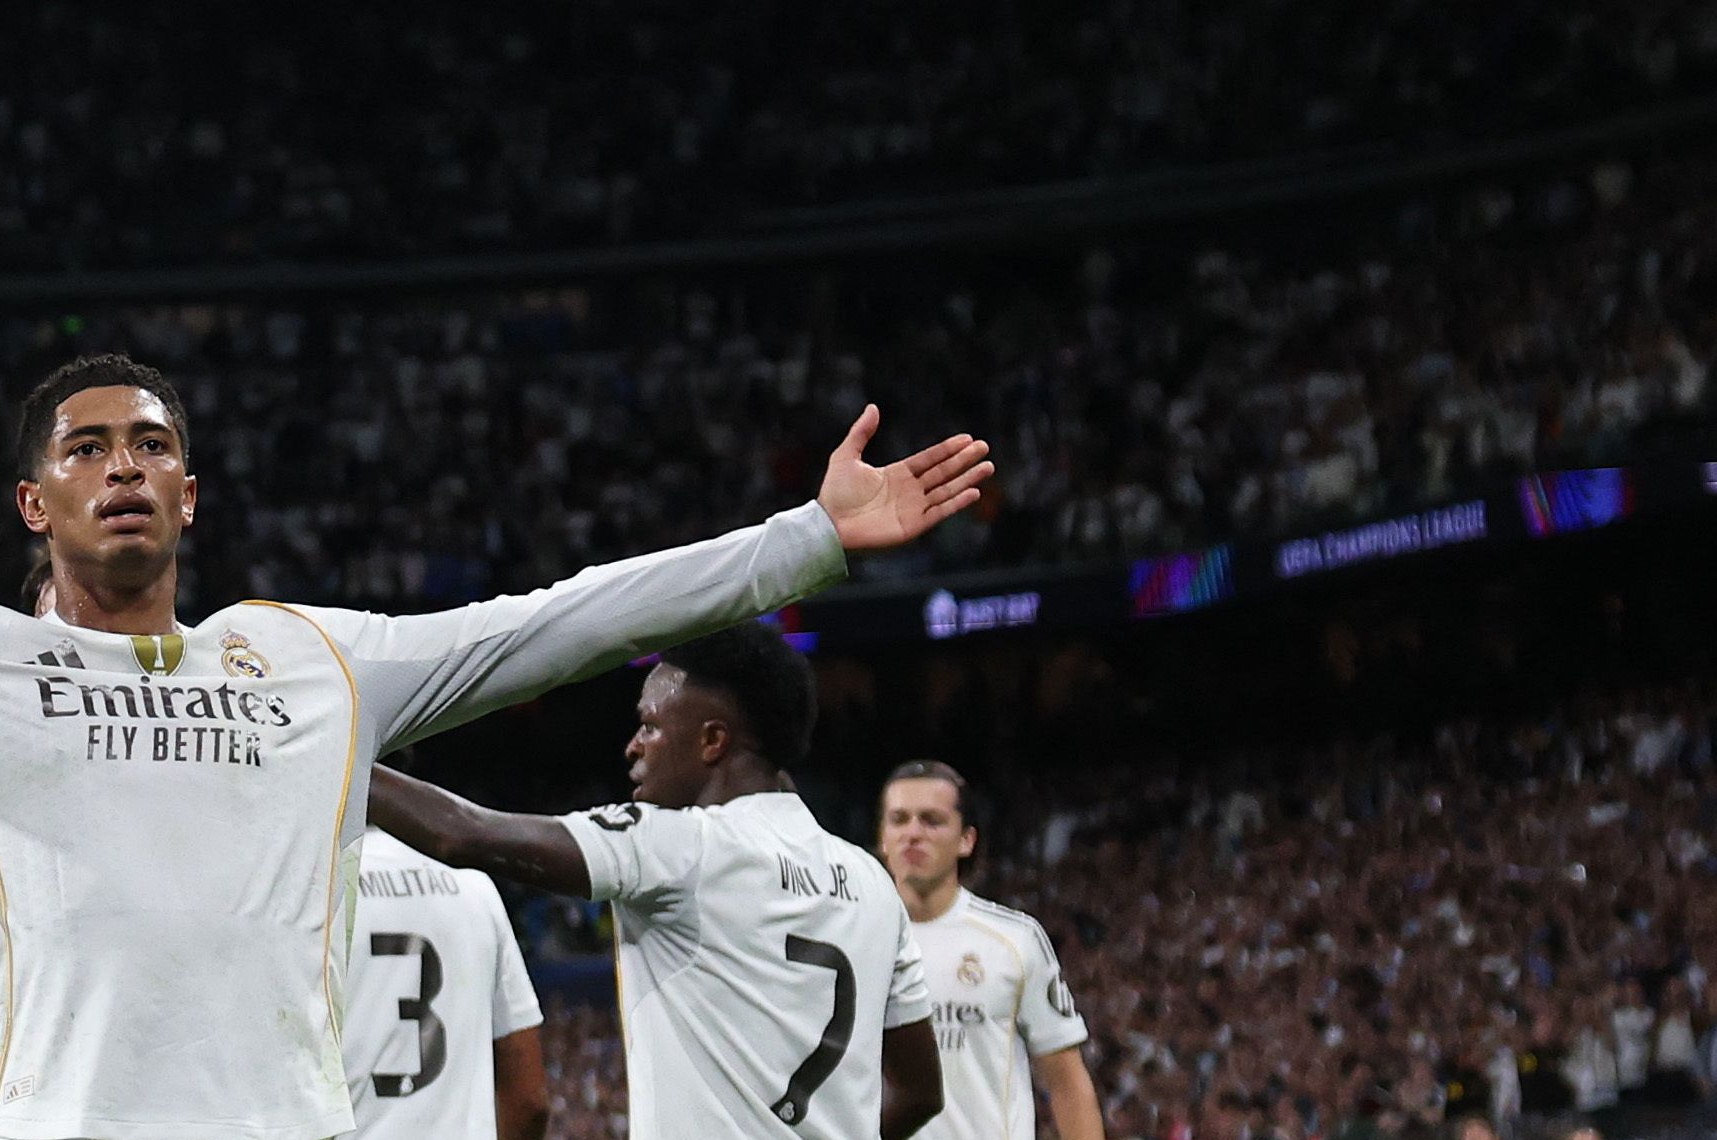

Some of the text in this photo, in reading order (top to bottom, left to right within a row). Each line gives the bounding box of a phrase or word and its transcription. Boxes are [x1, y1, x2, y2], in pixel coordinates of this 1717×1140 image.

[34, 675, 292, 727] Emirates
[87, 725, 261, 767] FLY BETTER
[776, 852, 859, 902] VINI JR.
[370, 932, 447, 1098] 3
[770, 933, 857, 1126] 7
